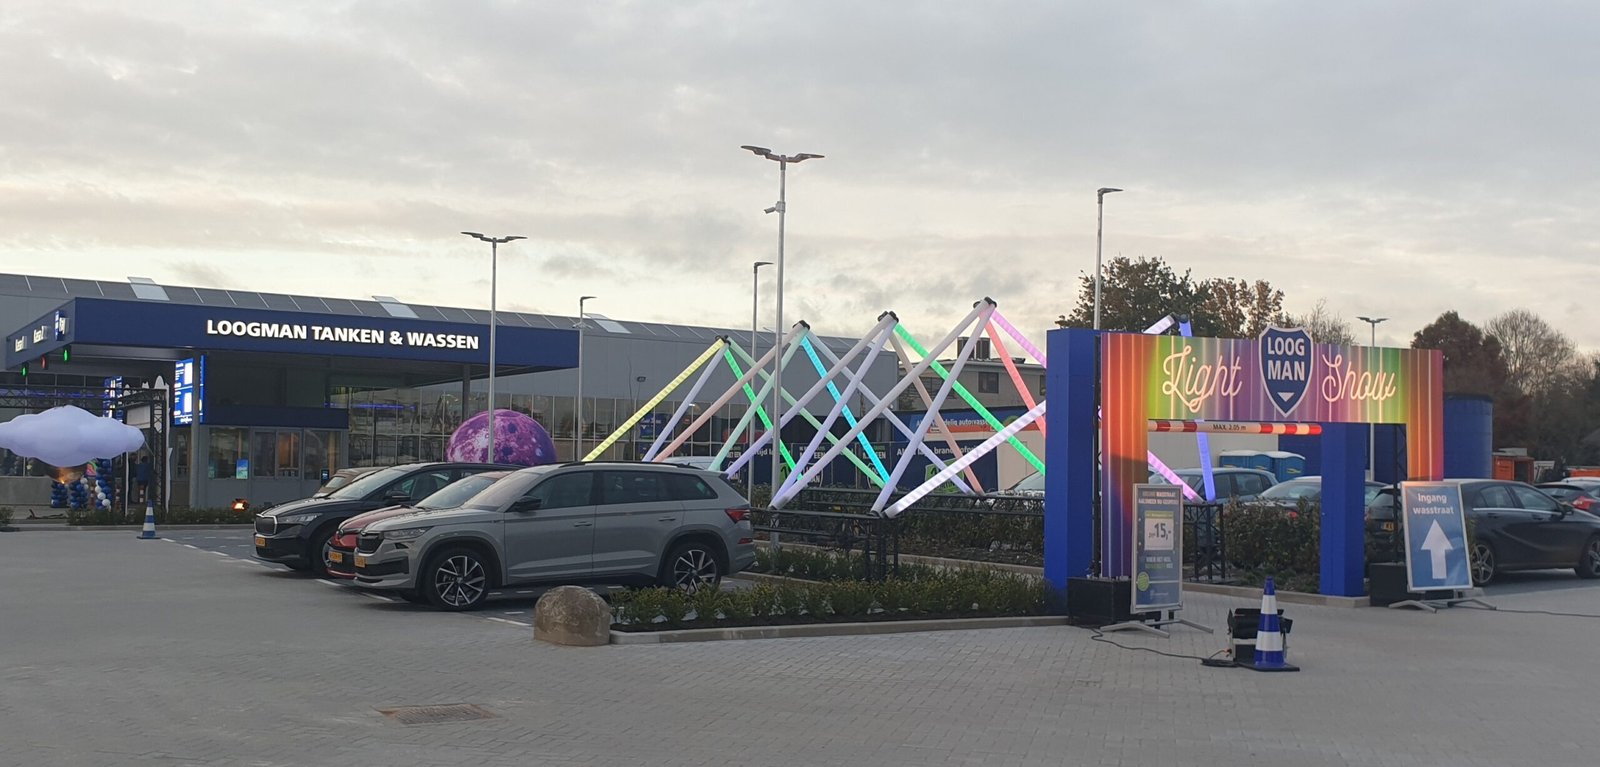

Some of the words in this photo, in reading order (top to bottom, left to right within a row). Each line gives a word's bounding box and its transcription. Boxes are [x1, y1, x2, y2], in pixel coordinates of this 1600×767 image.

[207, 319, 307, 340] LOOGMAN
[311, 326, 384, 344] TANKEN
[389, 331, 403, 345] &
[407, 332, 479, 349] WASSEN
[1267, 336, 1305, 356] LOOG
[1162, 345, 1243, 413] Light
[1322, 354, 1396, 402] Show
[1267, 360, 1305, 381] MAN
[1418, 493, 1447, 504] Ingang
[1413, 506, 1454, 515] wasstraat
